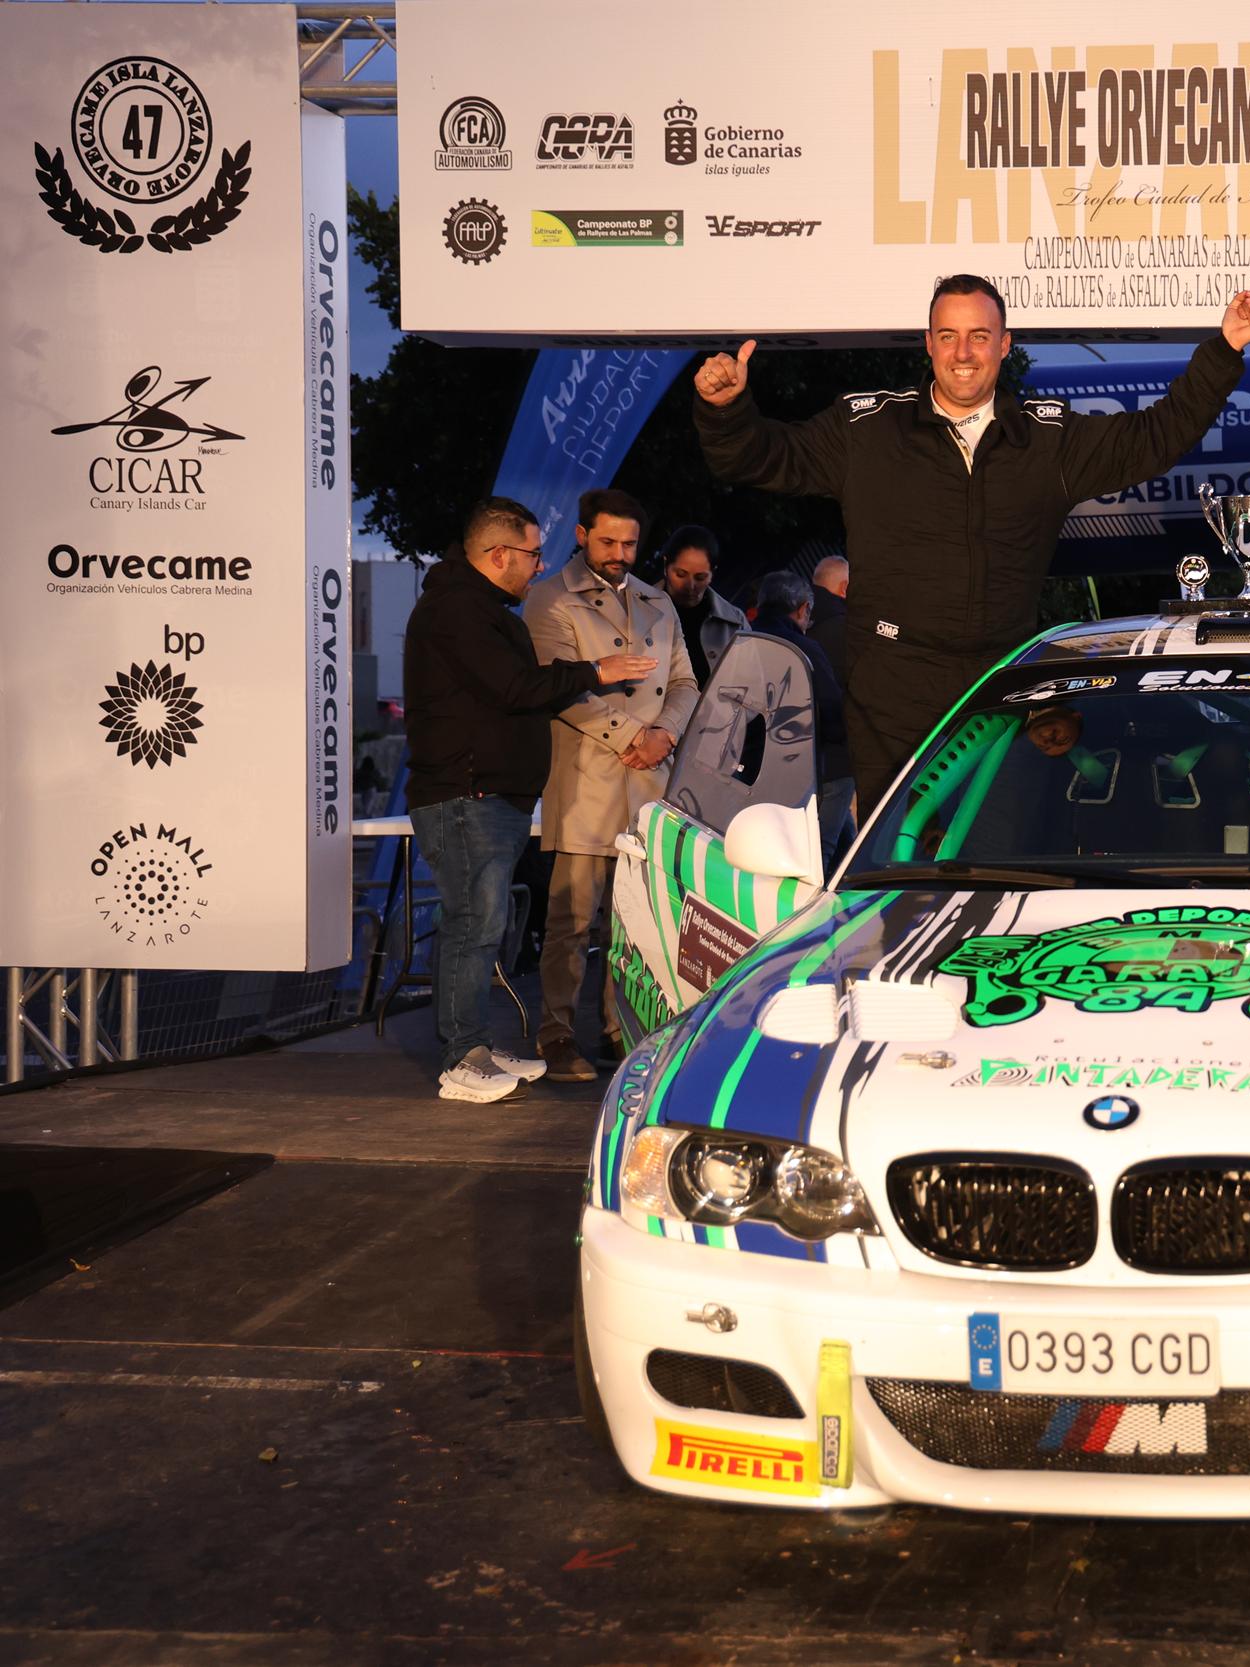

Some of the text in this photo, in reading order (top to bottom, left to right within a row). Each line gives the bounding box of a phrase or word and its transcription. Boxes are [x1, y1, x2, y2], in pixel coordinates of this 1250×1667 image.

[79, 62, 207, 197] ORVECAME ISLA LANZAROTE
[122, 105, 163, 159] 47
[457, 115, 489, 144] FCA
[705, 126, 784, 141] Gobierno
[966, 72, 1086, 169] RALLYE
[439, 153, 509, 168] AUTOMOVILISMO
[705, 143, 802, 158] de Canarias
[705, 164, 770, 177] islas iguales
[1056, 180, 1125, 222] Trofeo
[1134, 184, 1213, 207] Ciudad
[1209, 184, 1234, 205] de
[577, 219, 653, 231] Campeonato BP
[587, 230, 608, 238] Rallyes
[1024, 236, 1121, 270] CAMPEONATO
[1125, 244, 1135, 269] de
[1137, 234, 1208, 268] CANARIAS
[1211, 242, 1221, 268] de
[1033, 284, 1043, 309] de
[1046, 274, 1104, 309] RALLYES
[1106, 284, 1116, 307] de
[1119, 274, 1180, 308] ASFALTO
[1182, 282, 1193, 307] de
[1196, 273, 1221, 307] LAS
[318, 220, 339, 491] Orvecame
[851, 398, 876, 410] OMP
[1037, 407, 1062, 418] OMP
[89, 456, 206, 495] CICAR
[90, 497, 207, 512] Canary Islands Car
[48, 544, 252, 581] Orvecame
[47, 582, 252, 596] Organización Vehículos Cabrera Medina
[164, 624, 205, 661] bp
[877, 623, 899, 638] OMP
[1067, 677, 1114, 690] EN-VIA
[322, 568, 342, 836] Orvecame
[91, 822, 213, 878] OPEN MALL
[95, 895, 209, 947] LANZAROTE
[1082, 985, 1214, 1012] 84
[978, 1358, 993, 1376] E
[1007, 1330, 1211, 1376] 0393 CGD
[1104, 1402, 1208, 1454] M
[667, 1432, 804, 1483] PIRELLI
[827, 1416, 841, 1478] sparco
